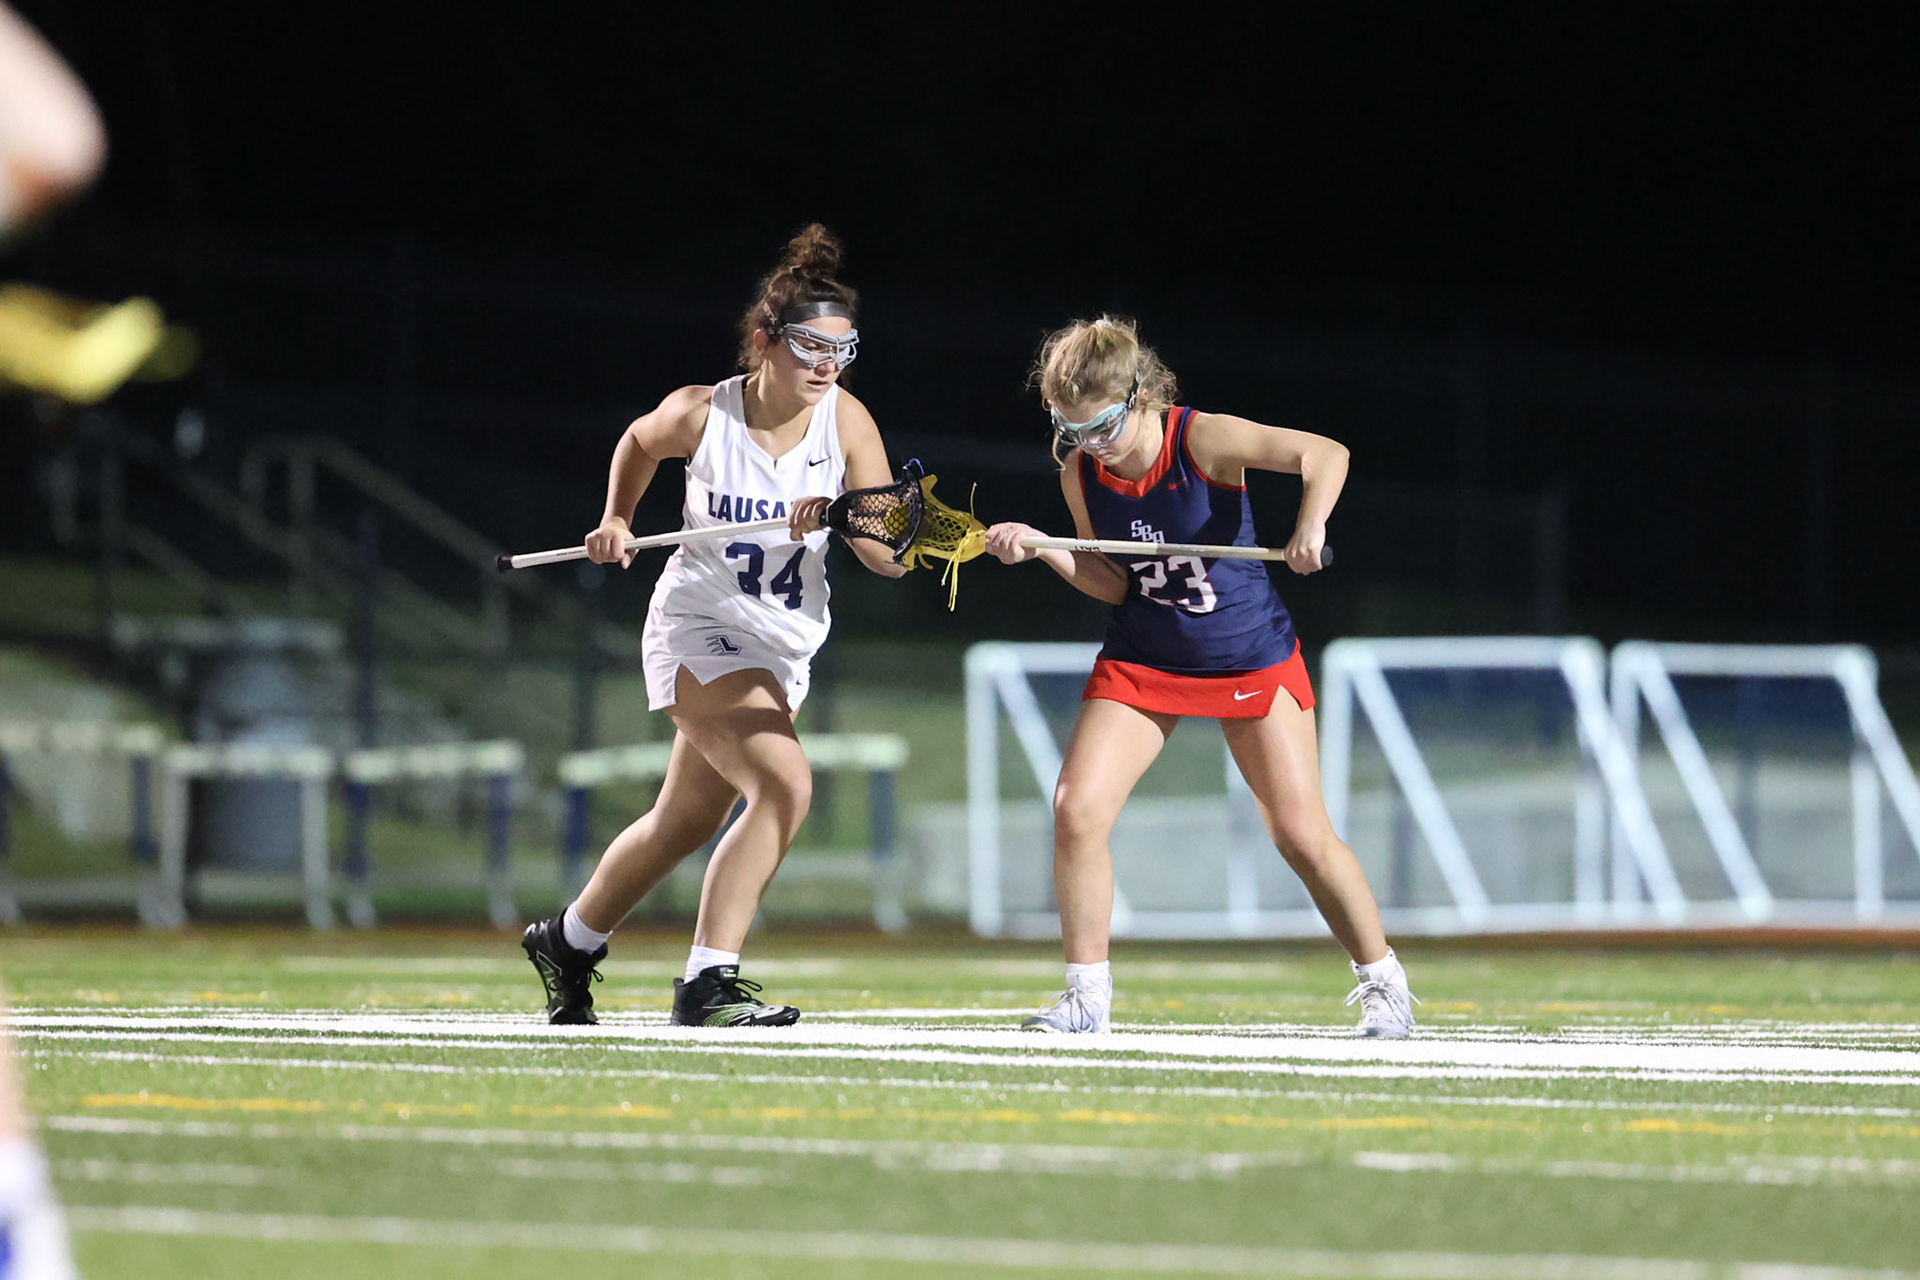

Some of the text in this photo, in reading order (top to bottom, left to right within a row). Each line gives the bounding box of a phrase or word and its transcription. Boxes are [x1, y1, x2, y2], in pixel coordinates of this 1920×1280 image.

[708, 491, 793, 524] LAUSA
[725, 542, 807, 610] 34
[1130, 556, 1217, 613] 23
